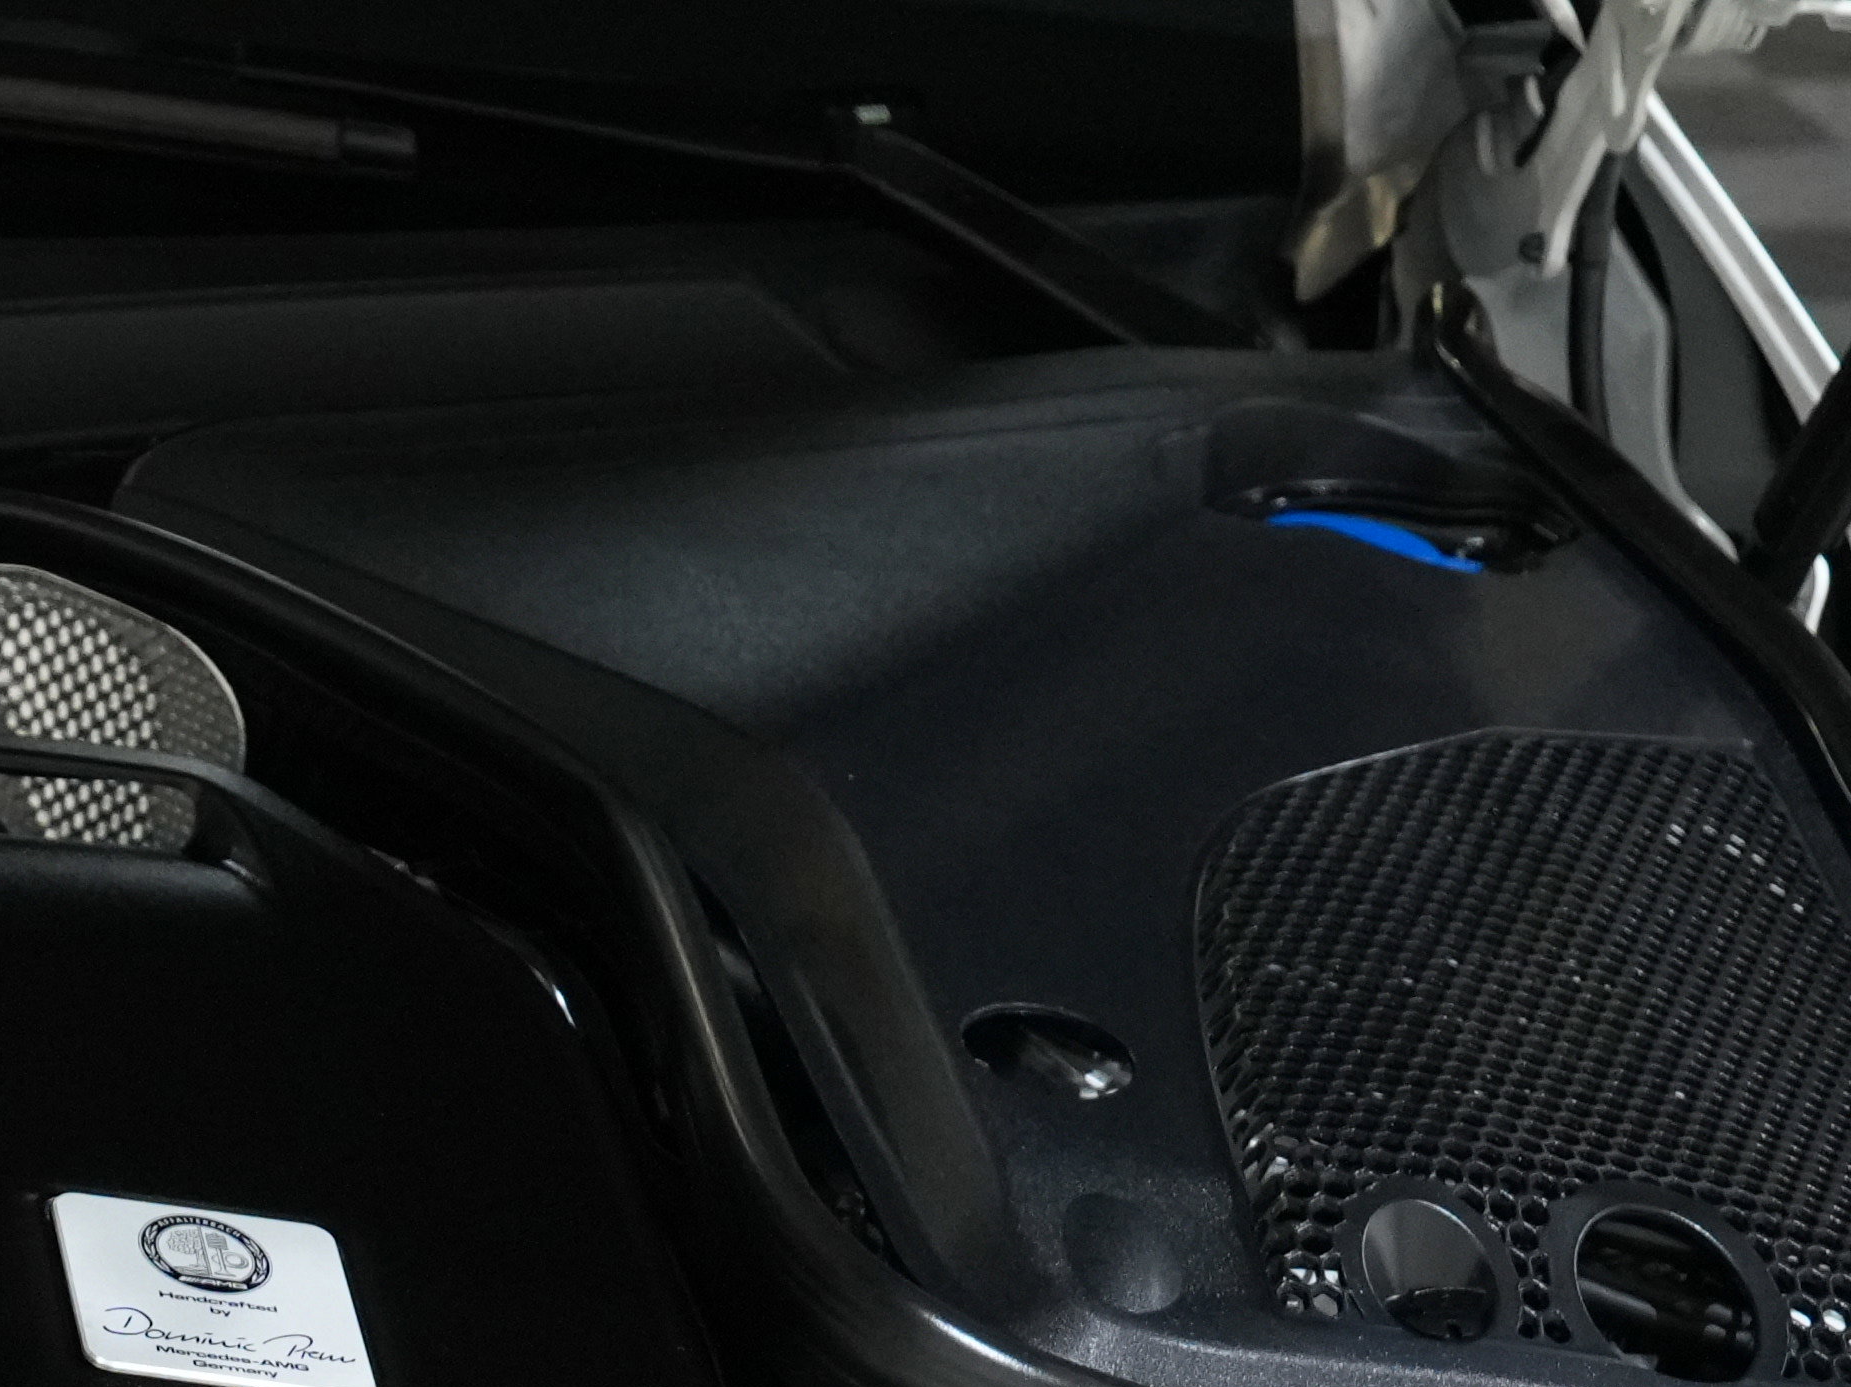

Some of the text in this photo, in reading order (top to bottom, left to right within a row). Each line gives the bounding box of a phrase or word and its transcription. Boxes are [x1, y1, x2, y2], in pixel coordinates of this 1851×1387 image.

[158, 1290, 278, 1313] Handcrafted
[210, 1306, 231, 1317] by
[156, 1345, 309, 1372] Mercedes-AMG
[193, 1359, 278, 1379] Germany
